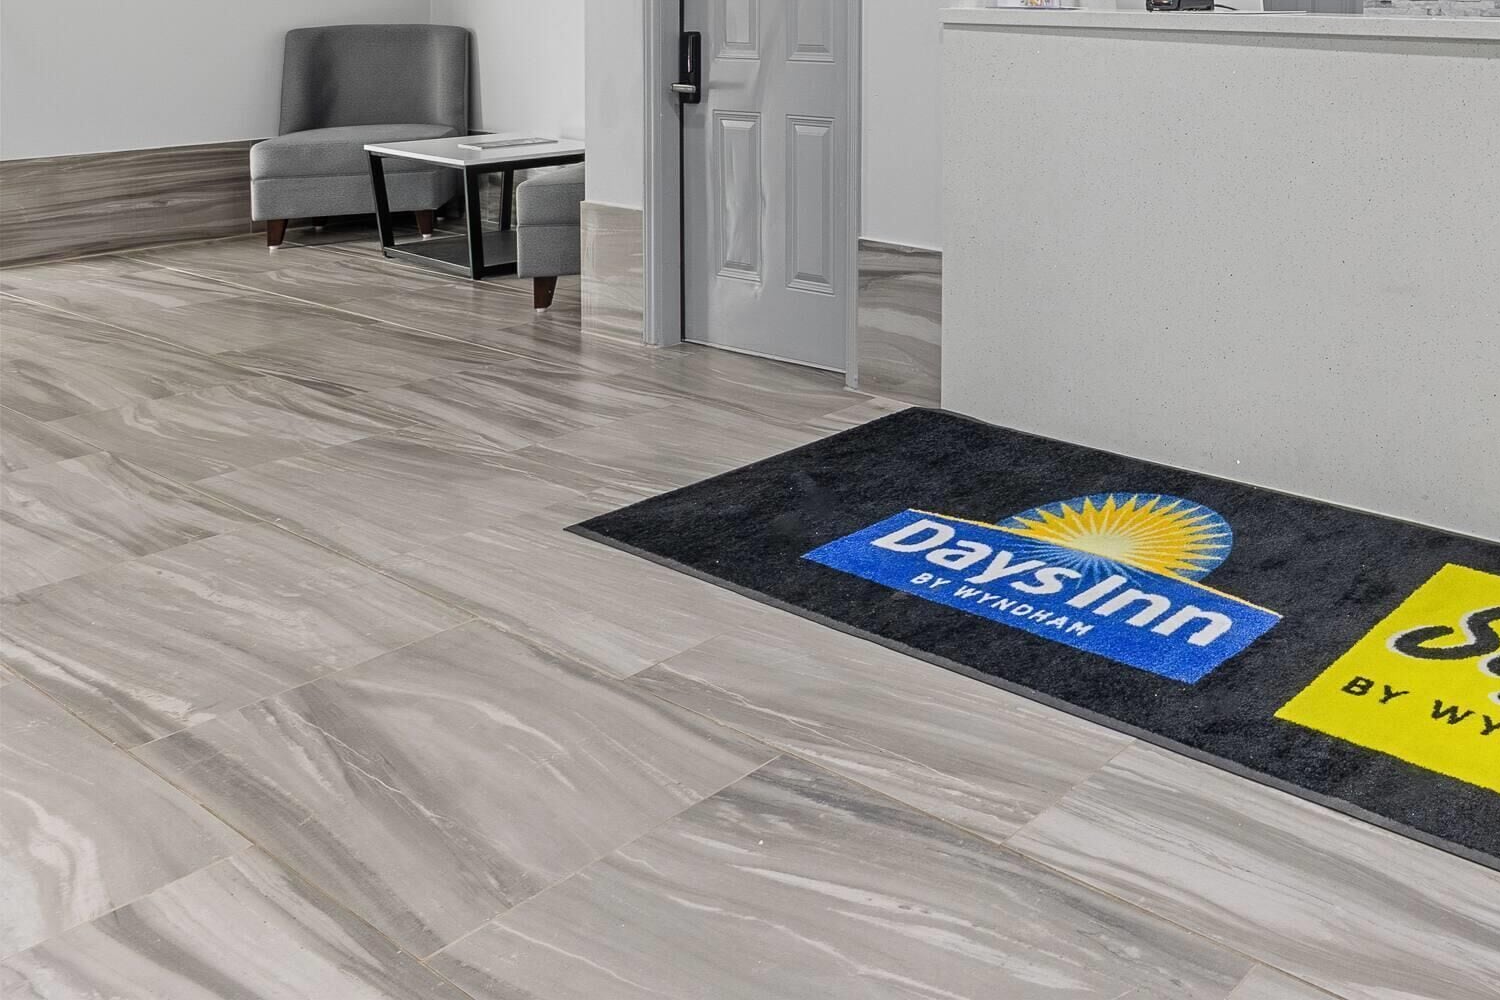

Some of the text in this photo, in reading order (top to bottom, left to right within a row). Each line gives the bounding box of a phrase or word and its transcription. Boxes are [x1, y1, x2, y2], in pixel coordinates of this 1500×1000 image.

[869, 518, 1233, 646] Days Inn
[909, 573, 1097, 638] BY WYNDHAM
[1341, 675, 1410, 704] BY
